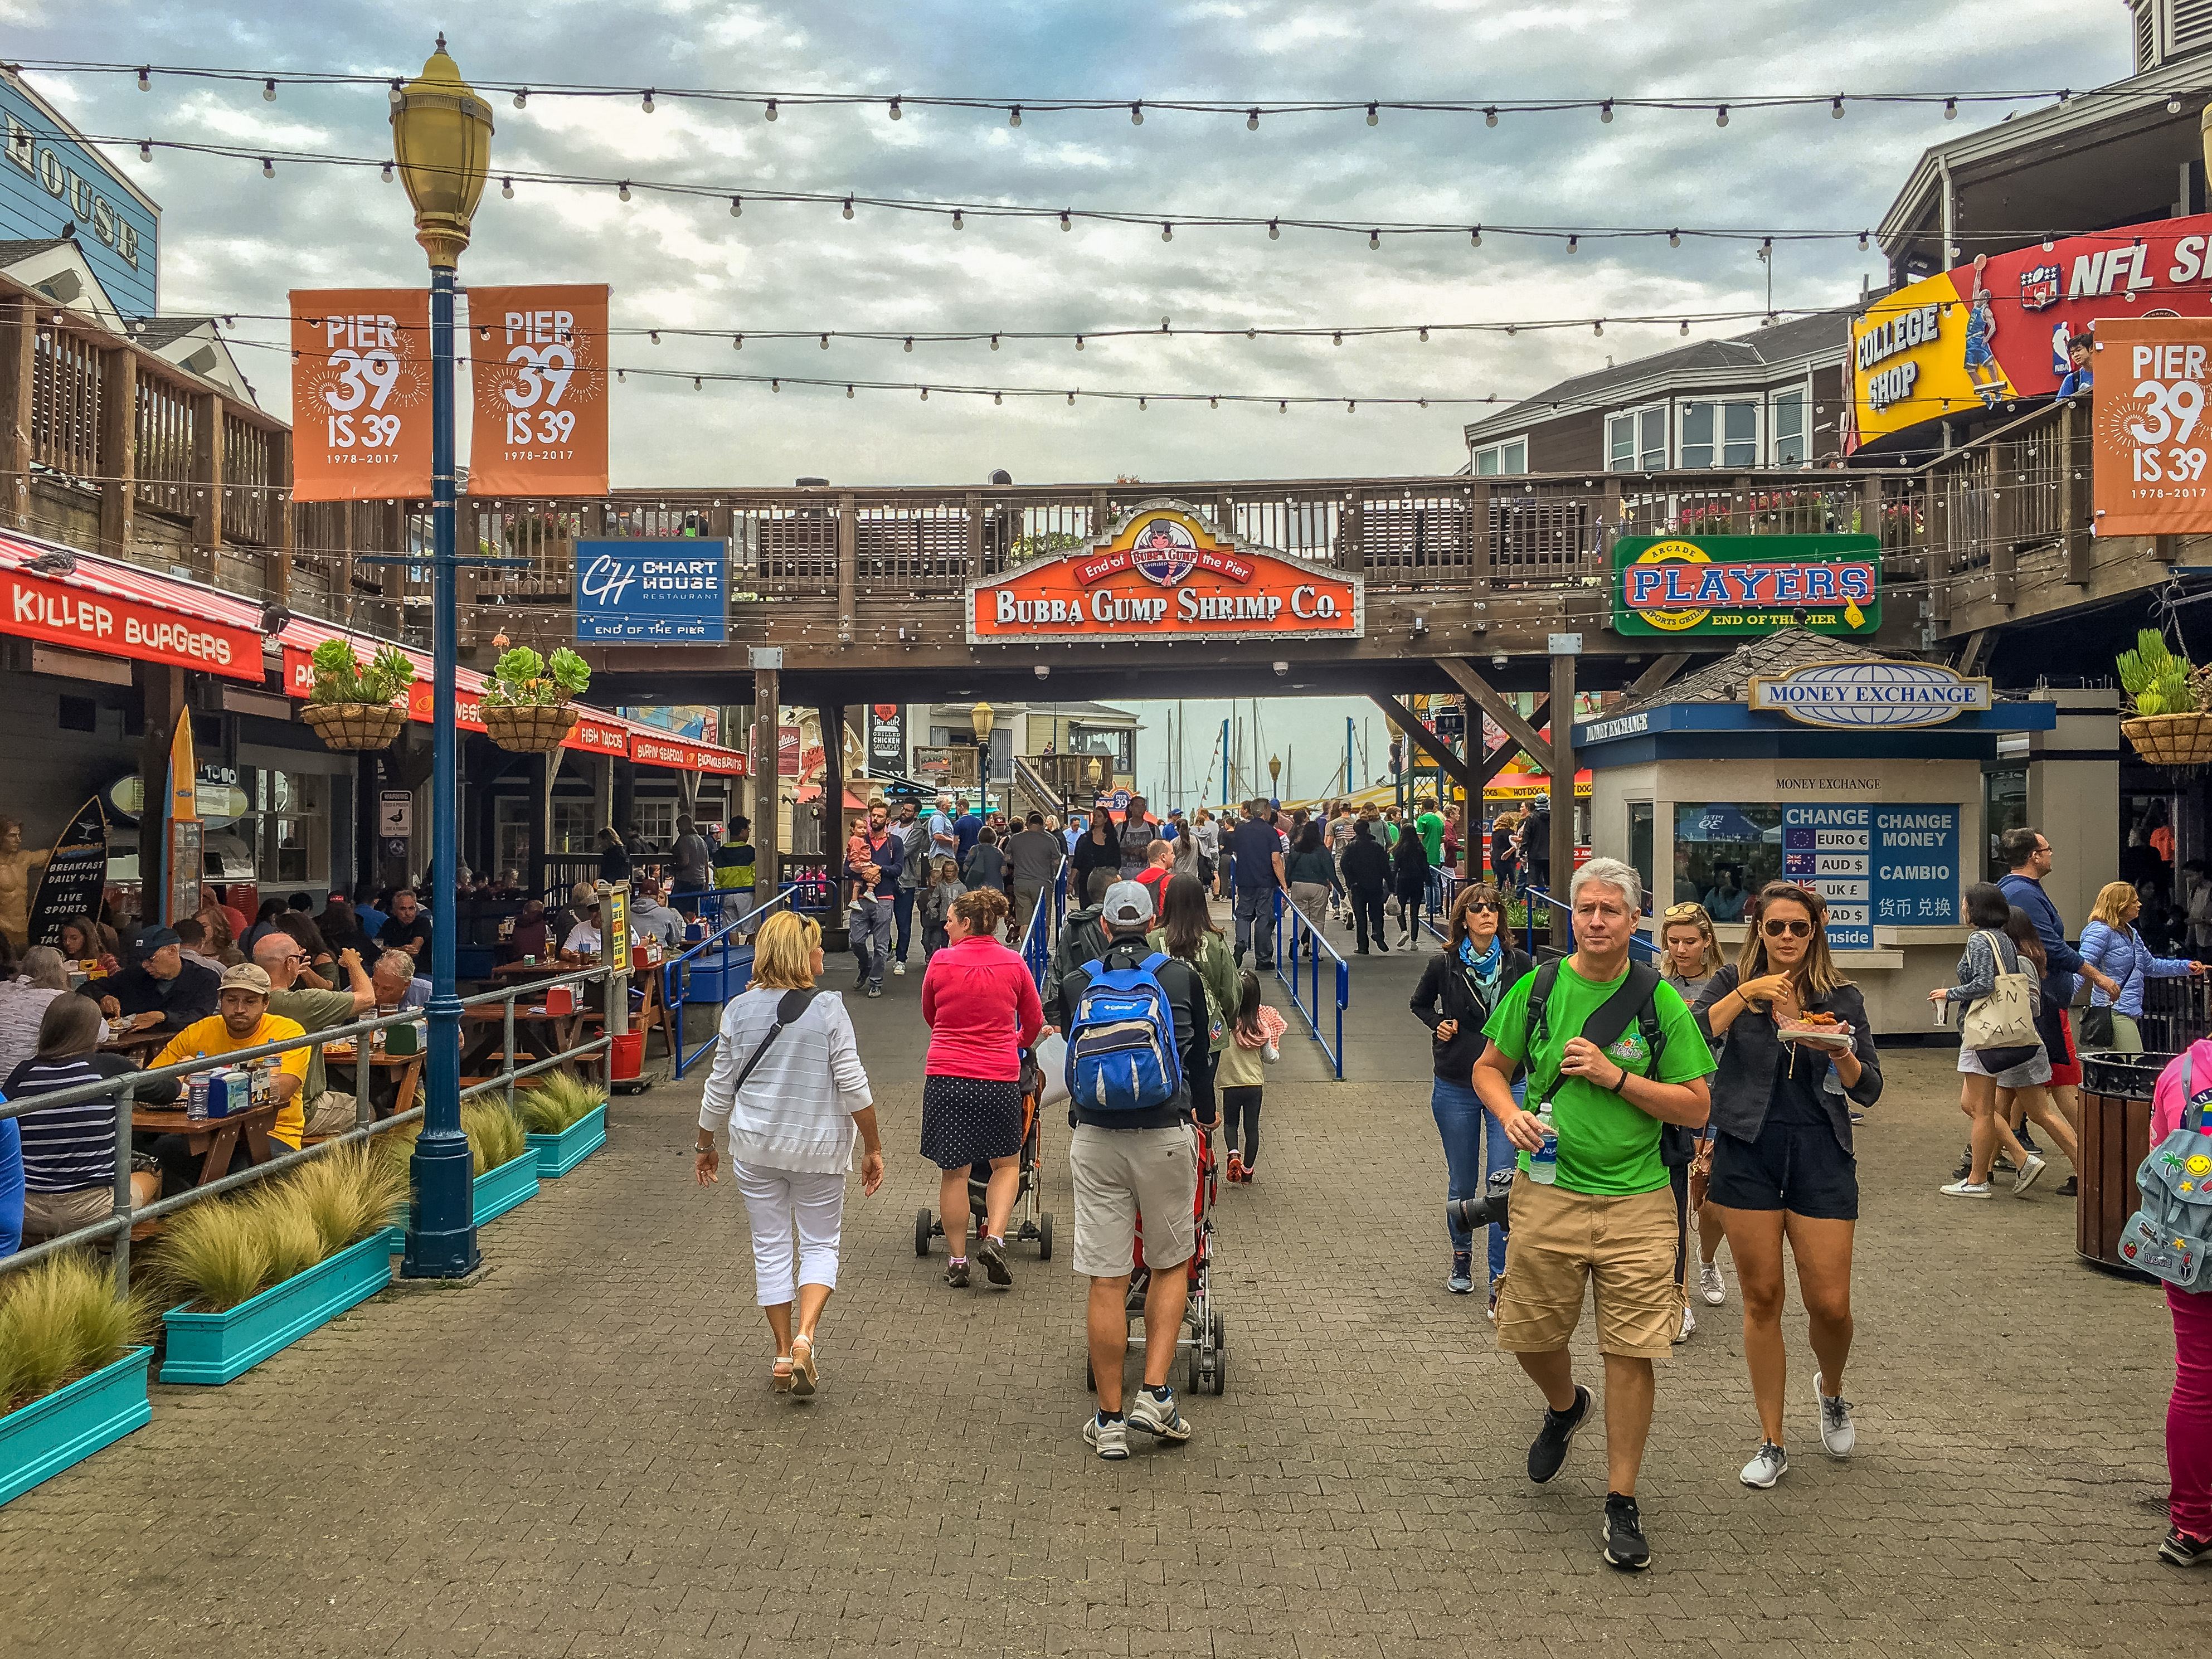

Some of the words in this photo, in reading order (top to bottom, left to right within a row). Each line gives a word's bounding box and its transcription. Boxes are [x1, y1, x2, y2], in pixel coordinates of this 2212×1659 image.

[3, 113, 139, 273] HOUSE
[2068, 244, 2153, 300] NFL
[327, 314, 400, 348] PIER
[505, 310, 575, 345] PIER
[1858, 303, 1939, 372] COLLEGE
[2054, 364, 2069, 373] NBA
[2133, 345, 2206, 380] PIER
[325, 349, 400, 412] 39
[505, 344, 576, 408] 39
[1868, 361, 1916, 411] SHOP
[2131, 380, 2205, 445] 39
[328, 413, 356, 447] IS
[361, 414, 402, 448] 39
[507, 412, 532, 445] IS
[538, 410, 576, 444] 39
[2133, 449, 2162, 483] IS
[2169, 448, 2207, 482] 39
[1168, 549, 1197, 562] GUMP
[1651, 544, 1696, 558] ARCADE
[643, 561, 718, 575] CHART
[1085, 558, 1110, 578] End
[1110, 553, 1125, 567] of
[1224, 560, 1249, 577] Pier
[582, 554, 636, 606] CH
[643, 577, 718, 590] HOUSE
[1633, 567, 1869, 602] PLAYERS
[12, 583, 113, 638] KILLER
[125, 616, 233, 665] BURGERS
[1712, 615, 1743, 625] END
[1747, 615, 1768, 625] OF
[1769, 684, 1850, 703] MONEY
[1856, 684, 1977, 703] EXCHANGE
[873, 714, 884, 726] TRY
[1609, 713, 1648, 737] EXCHANGE
[581, 728, 599, 744] FISH
[601, 731, 623, 750] TACOS
[659, 747, 684, 763] SEAFOOD
[1776, 779, 1816, 790] MONEY
[1818, 779, 1882, 790] EXCHANGE
[1115, 799, 1128, 809] 39
[1786, 809, 1869, 825] CHANGE
[1877, 814, 1952, 829] CHANGE
[1817, 834, 1855, 845] EURO
[1859, 834, 1868, 845] €
[1883, 833, 1947, 846] MONEY
[49, 861, 105, 873] BREAKFAST
[1821, 859, 1851, 870] AUD
[1854, 858, 1863, 872] $
[1880, 865, 1950, 880] CAMBIO
[48, 874, 77, 884] DAILY
[79, 873, 98, 882] 9-11
[57, 893, 83, 902] LIVE
[1826, 884, 1847, 895] UK
[1850, 884, 1858, 895] £
[45, 904, 88, 914] SPORTS
[1854, 909, 1863, 922] $
[1825, 930, 1869, 943] nside
[1980, 1016, 2028, 1036] FAIT
[2145, 1253, 2172, 1269] LOVE
